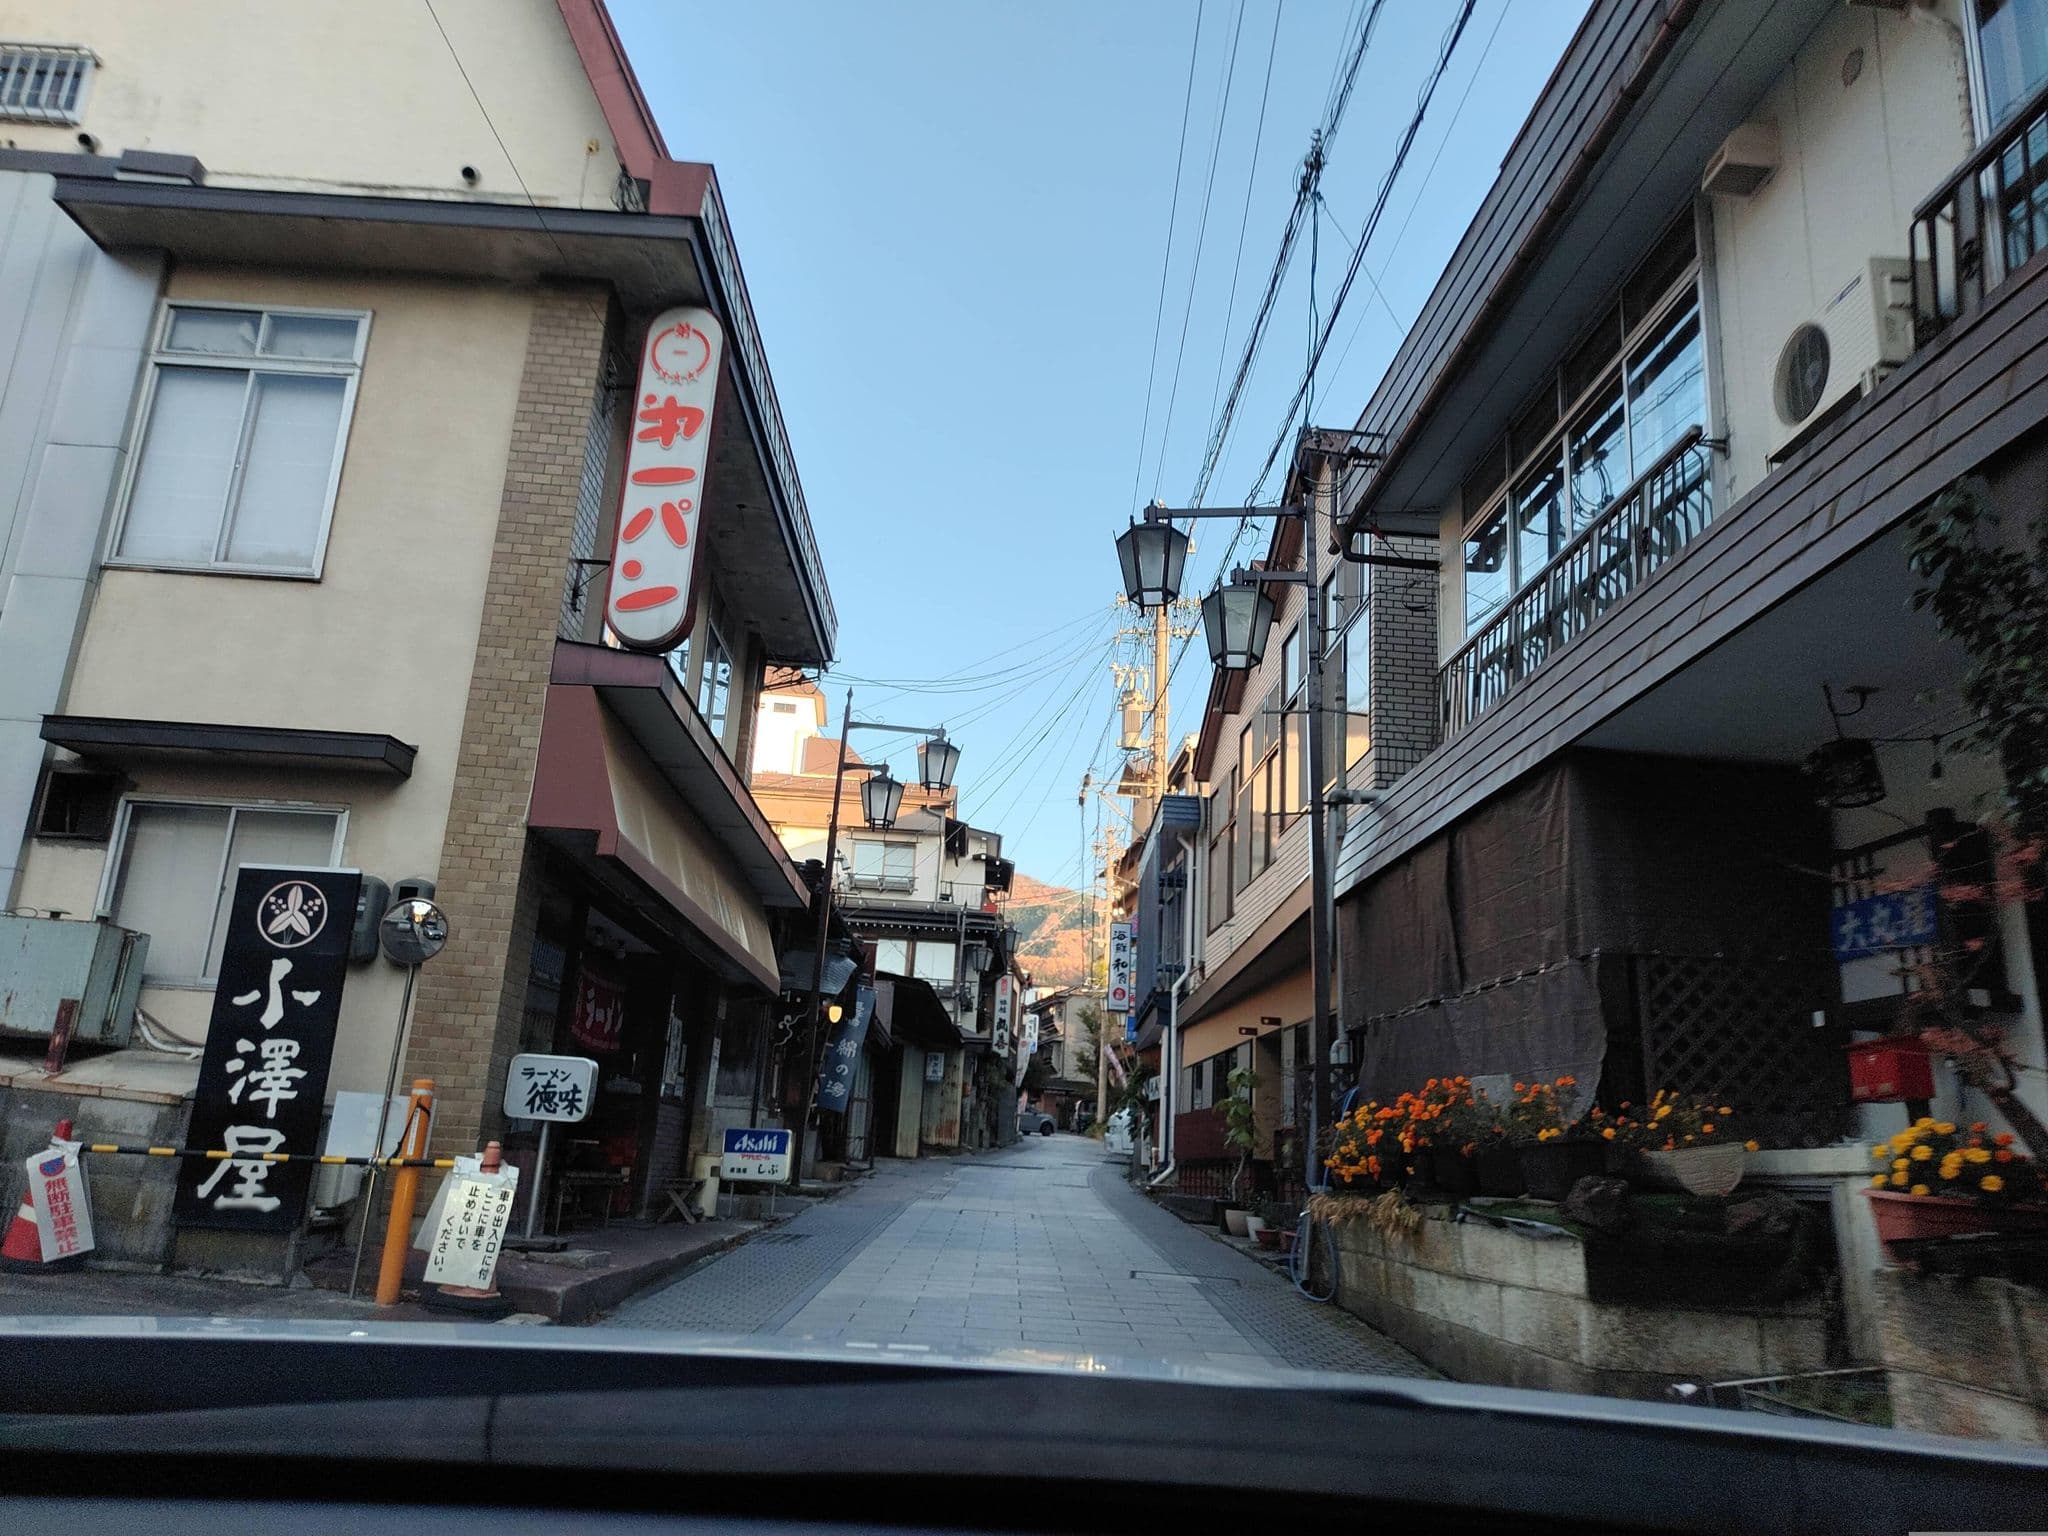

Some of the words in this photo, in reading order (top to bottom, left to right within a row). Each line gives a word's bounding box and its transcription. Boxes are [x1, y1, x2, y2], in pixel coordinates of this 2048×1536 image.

[197, 957, 323, 1214] 小澤屋
[521, 1067, 572, 1082] ラーメン
[524, 1080, 583, 1116] 徳味
[734, 1133, 779, 1152] Asahi
[44, 1176, 81, 1256] 無断駐車禁止
[434, 1215, 455, 1272] ください。
[455, 1185, 480, 1251] 止めないで
[471, 1186, 494, 1252] ここに車を
[478, 1190, 511, 1281] 車の出入口に付
